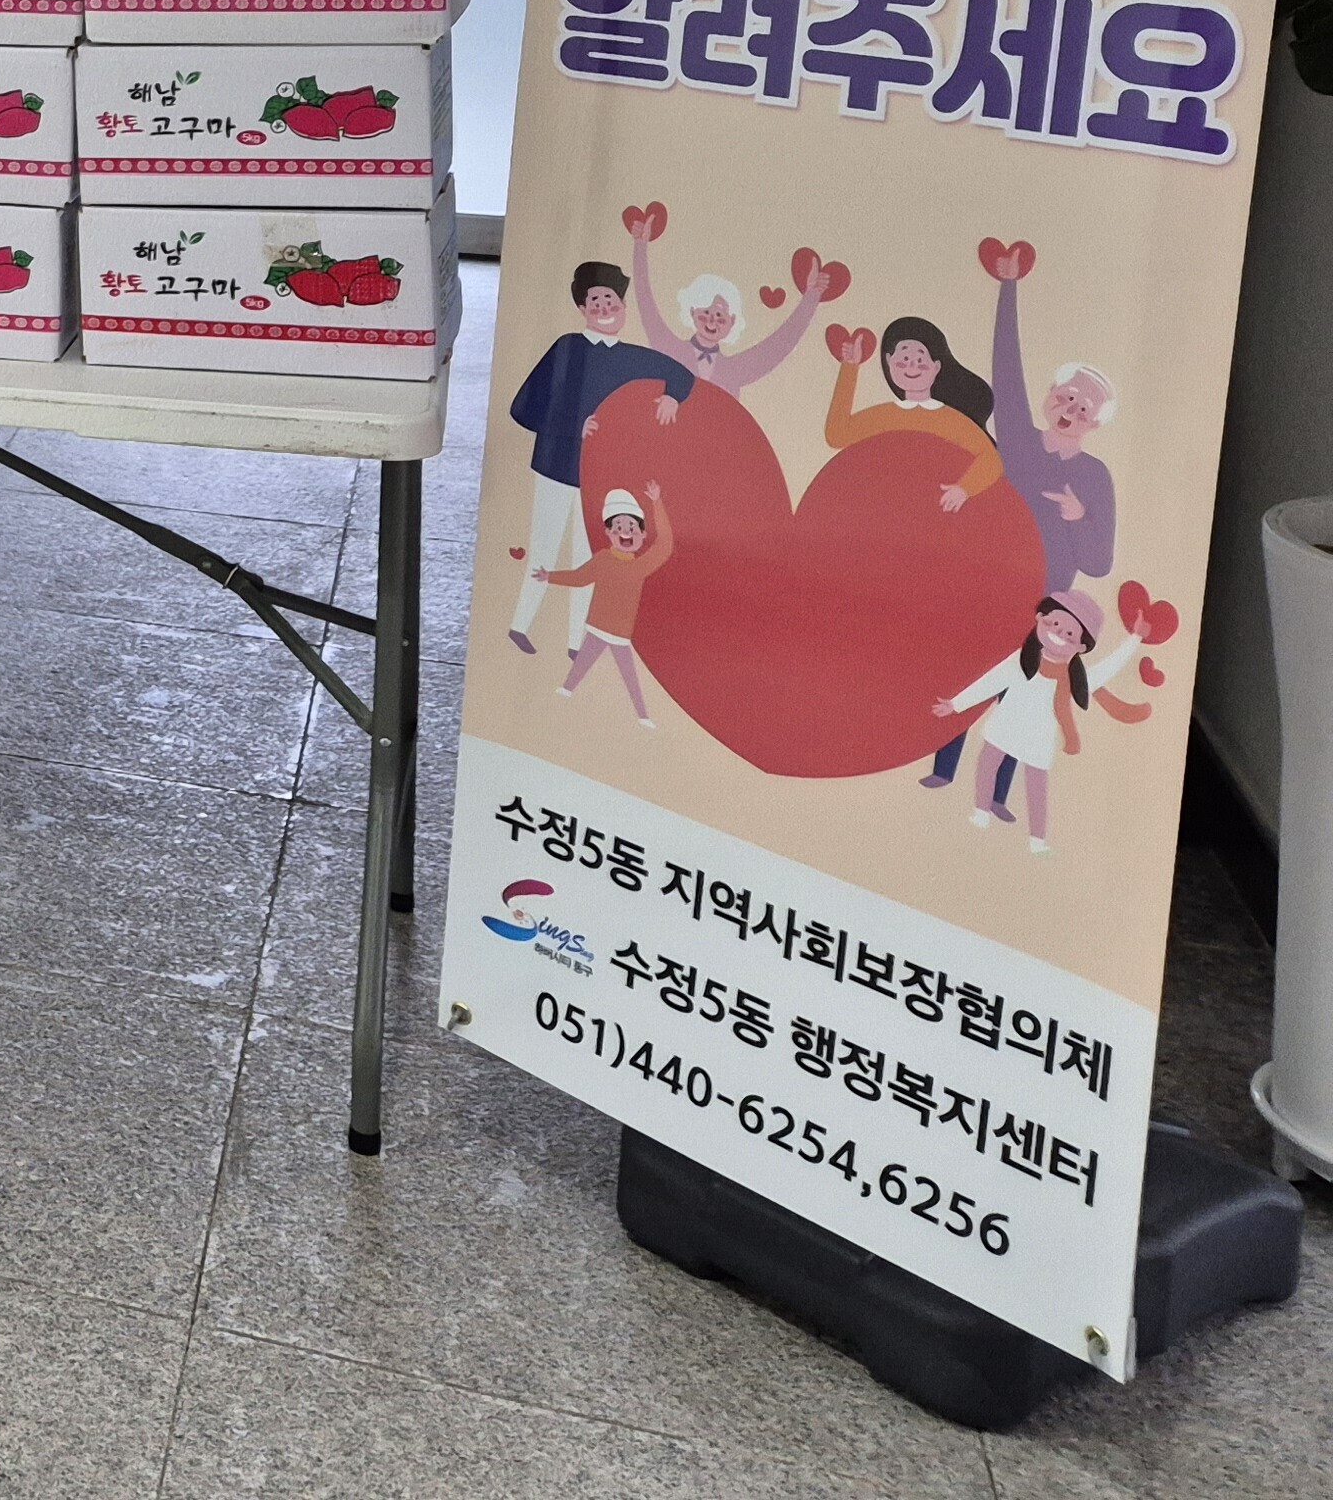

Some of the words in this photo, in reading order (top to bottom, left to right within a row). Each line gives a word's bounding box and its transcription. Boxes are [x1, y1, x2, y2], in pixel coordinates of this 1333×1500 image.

[129, 80, 180, 107] 해남
[97, 111, 143, 137] 황토
[150, 115, 235, 141] 고구마
[133, 241, 186, 267] 해남
[100, 270, 146, 296] 황토
[156, 275, 241, 301] 고구마
[495, 795, 650, 893] 수정5동
[660, 858, 1113, 1103] 지역사회보장협의체
[609, 940, 777, 1049] 수정5동
[790, 1014, 1101, 1208] 행정복지센터
[533, 991, 1013, 1258] 051)440-6254,6256
